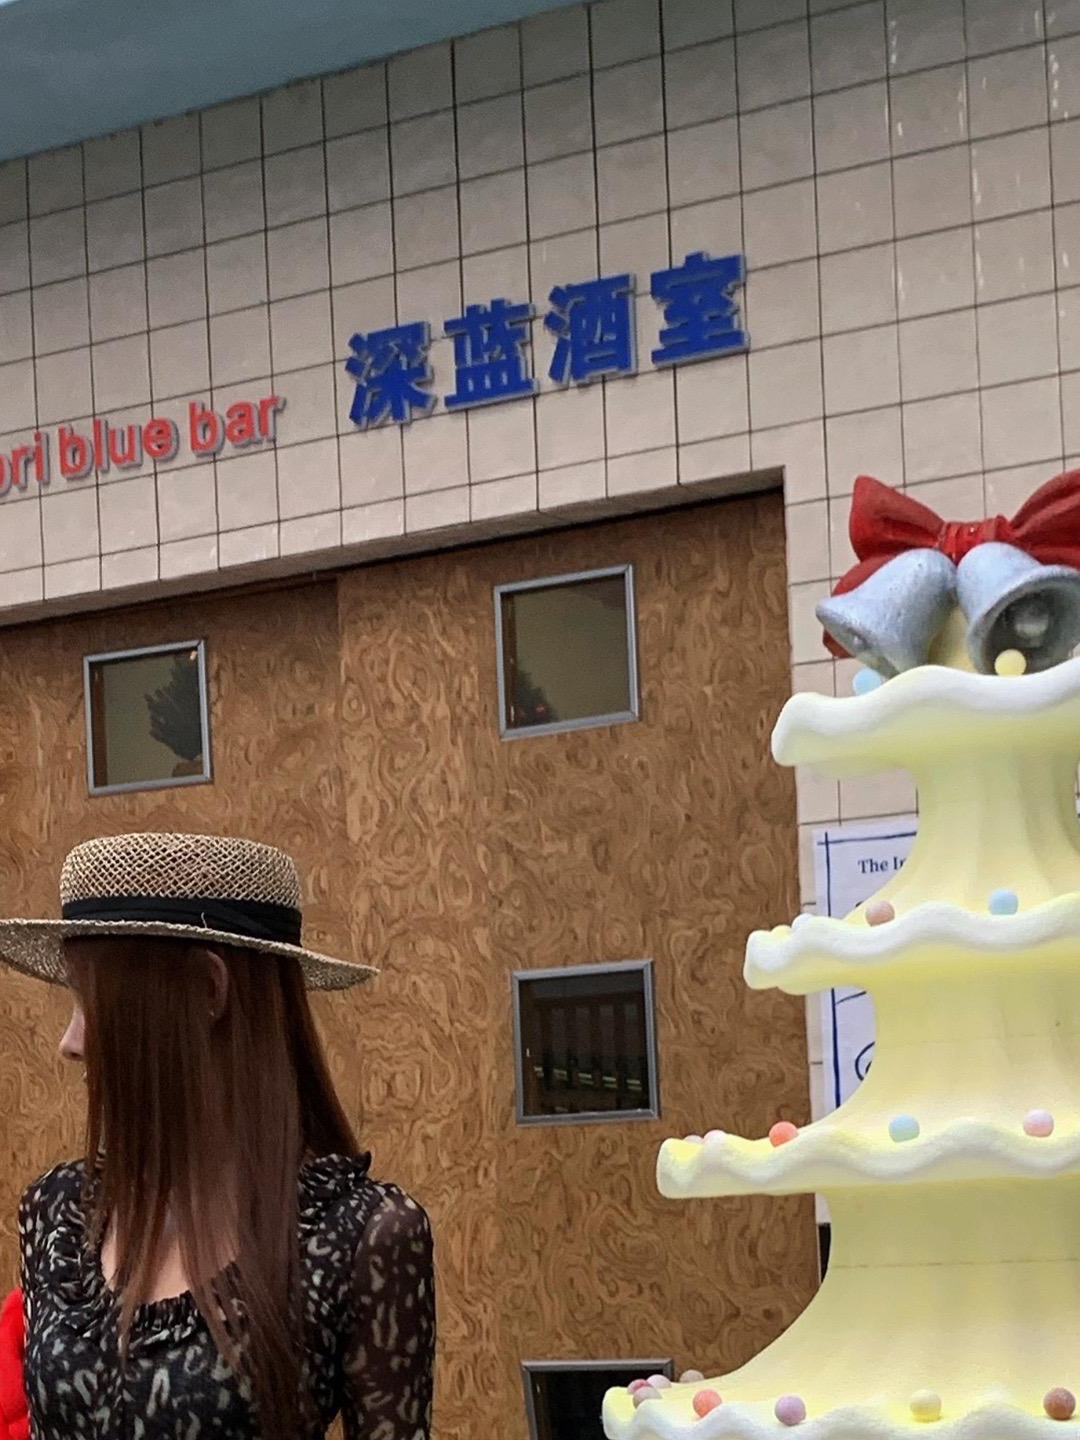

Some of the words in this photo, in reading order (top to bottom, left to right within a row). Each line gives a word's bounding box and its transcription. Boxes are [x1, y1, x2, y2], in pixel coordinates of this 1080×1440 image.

[345, 251, 750, 428] 深蓝酒室
[57, 416, 176, 478] blue
[188, 395, 284, 454] bar
[858, 858, 889, 874] The
